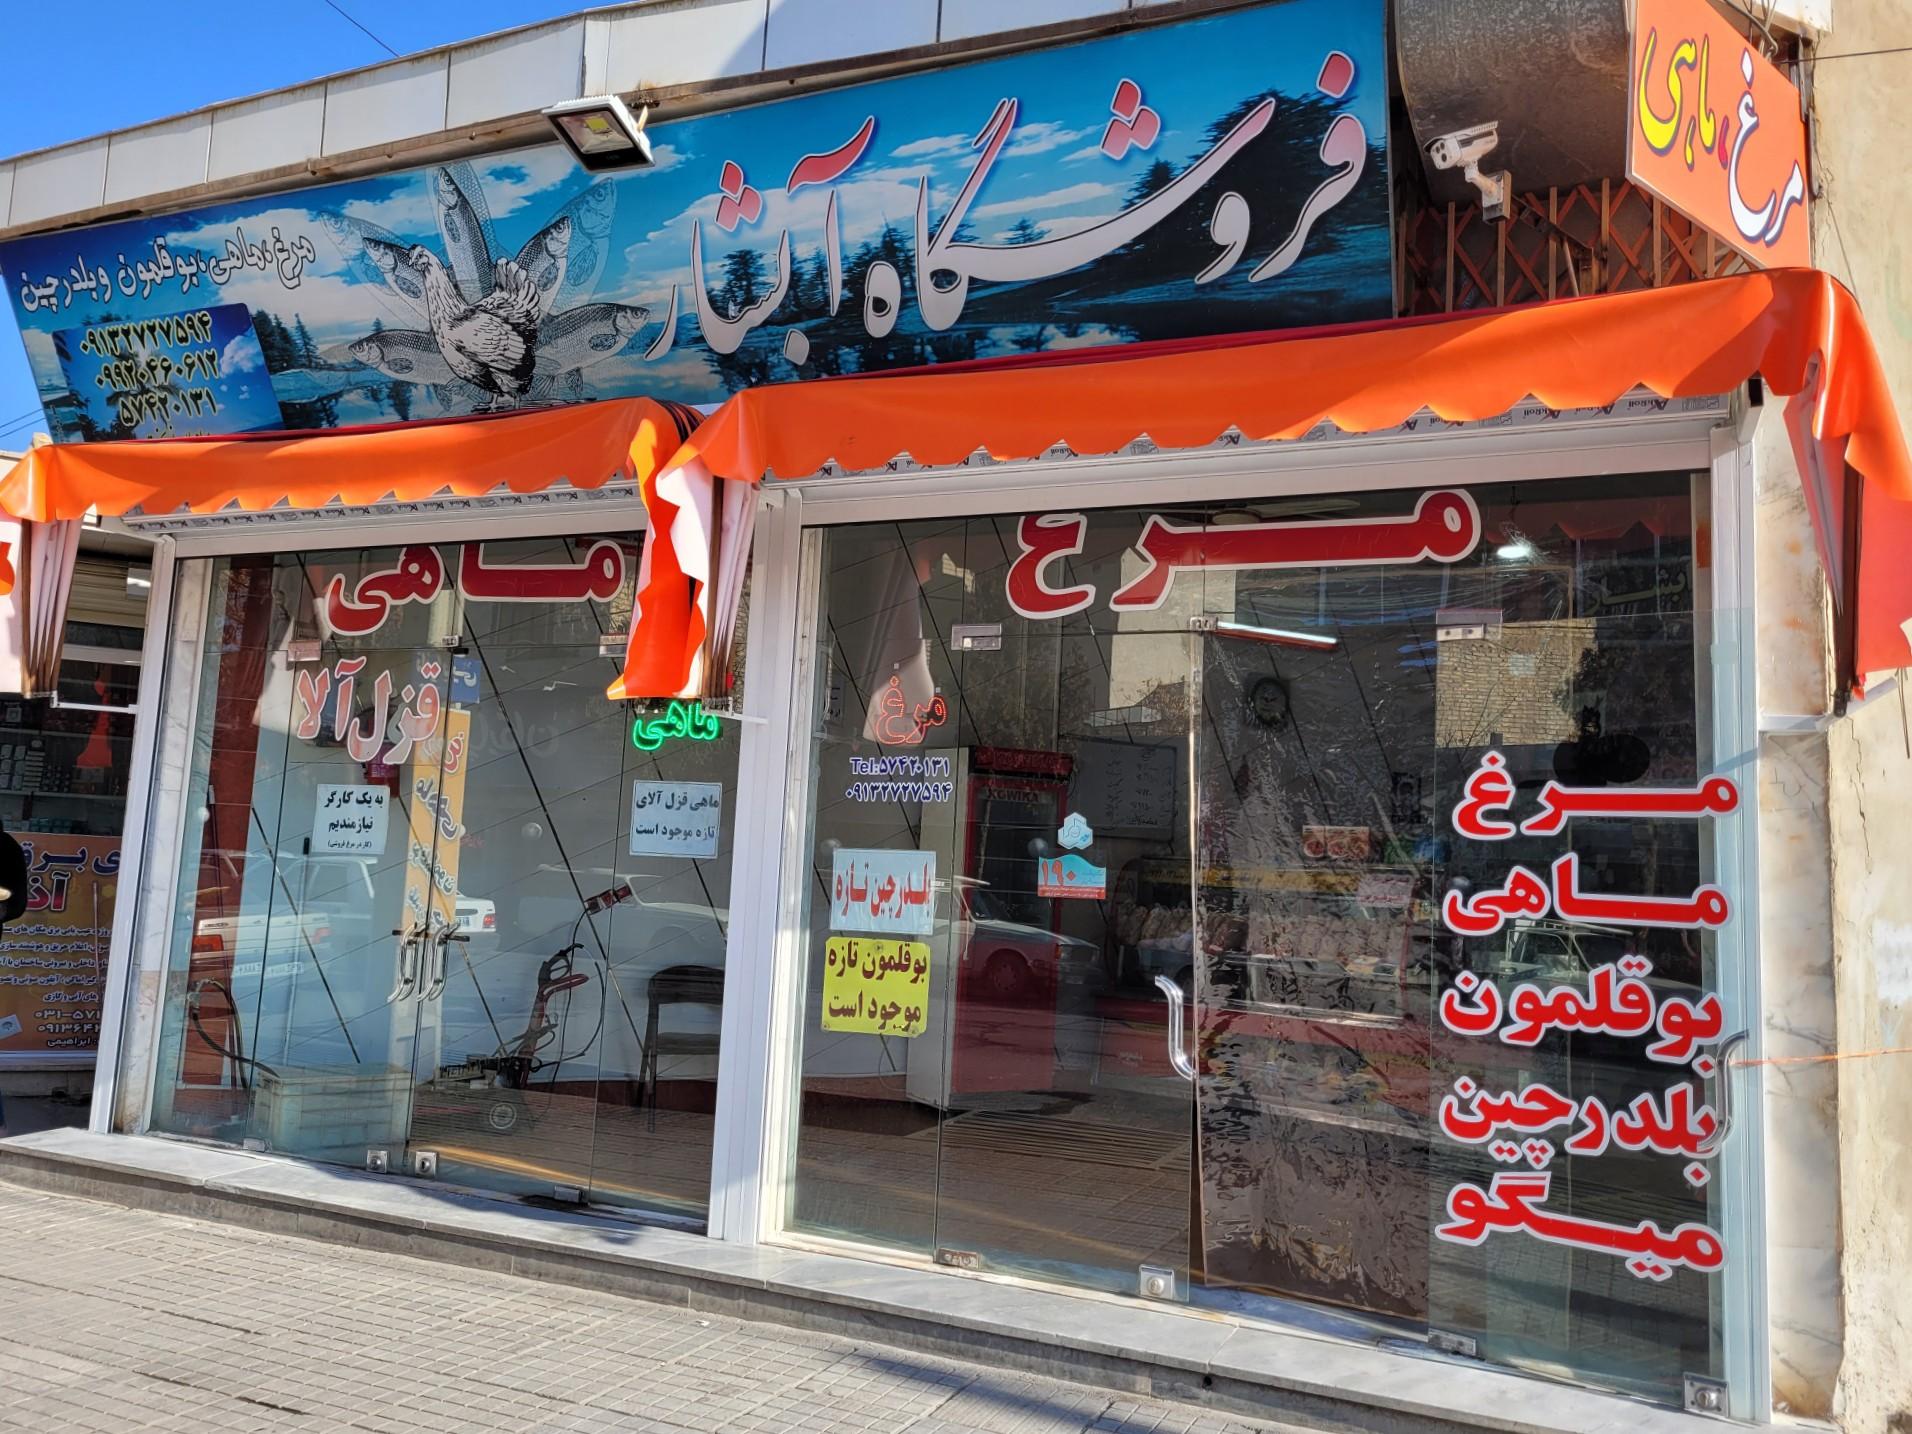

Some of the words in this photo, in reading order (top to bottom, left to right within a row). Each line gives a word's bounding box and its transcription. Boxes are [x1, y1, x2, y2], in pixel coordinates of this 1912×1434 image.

[864, 50, 1368, 338] فروشگاه
[644, 115, 876, 366] آبشار
[117, 235, 199, 301] بوقلمون
[80, 311, 213, 356] ۰۹۱۳۲۷۲۷۵۹۴
[119, 387, 218, 426] ۵۷۴۲۰۱۳۱
[328, 540, 626, 635] ماهی
[296, 656, 367, 740] آلا
[347, 662, 441, 764] قزل
[876, 676, 947, 744] مرغ
[633, 700, 721, 752] ماهی
[324, 790, 354, 808] کارگر
[355, 791, 372, 808] یک
[374, 794, 384, 809] به
[636, 790, 664, 809] آلای
[664, 791, 688, 811] قزل
[689, 794, 720, 811] ماهی
[845, 782, 953, 803] ۰۹۱۳۲۷۲۷۵۹۴
[1452, 750, 1740, 840] مرغ
[328, 816, 374, 833] نیازمندیم
[635, 823, 659, 836] است
[661, 826, 693, 841] موجود
[695, 825, 716, 841] تازه
[836, 858, 869, 917] تازه
[870, 862, 931, 918] بلدرچین
[1443, 852, 1732, 936] ماهی
[828, 940, 858, 977] تازه
[861, 942, 927, 984] بوقلمون
[828, 990, 863, 1019] است
[867, 997, 922, 1032] موجود
[1440, 956, 1726, 1078] بوقلمون
[1440, 1076, 1722, 1187] بلدرچین
[1435, 1171, 1726, 1281] میگو
